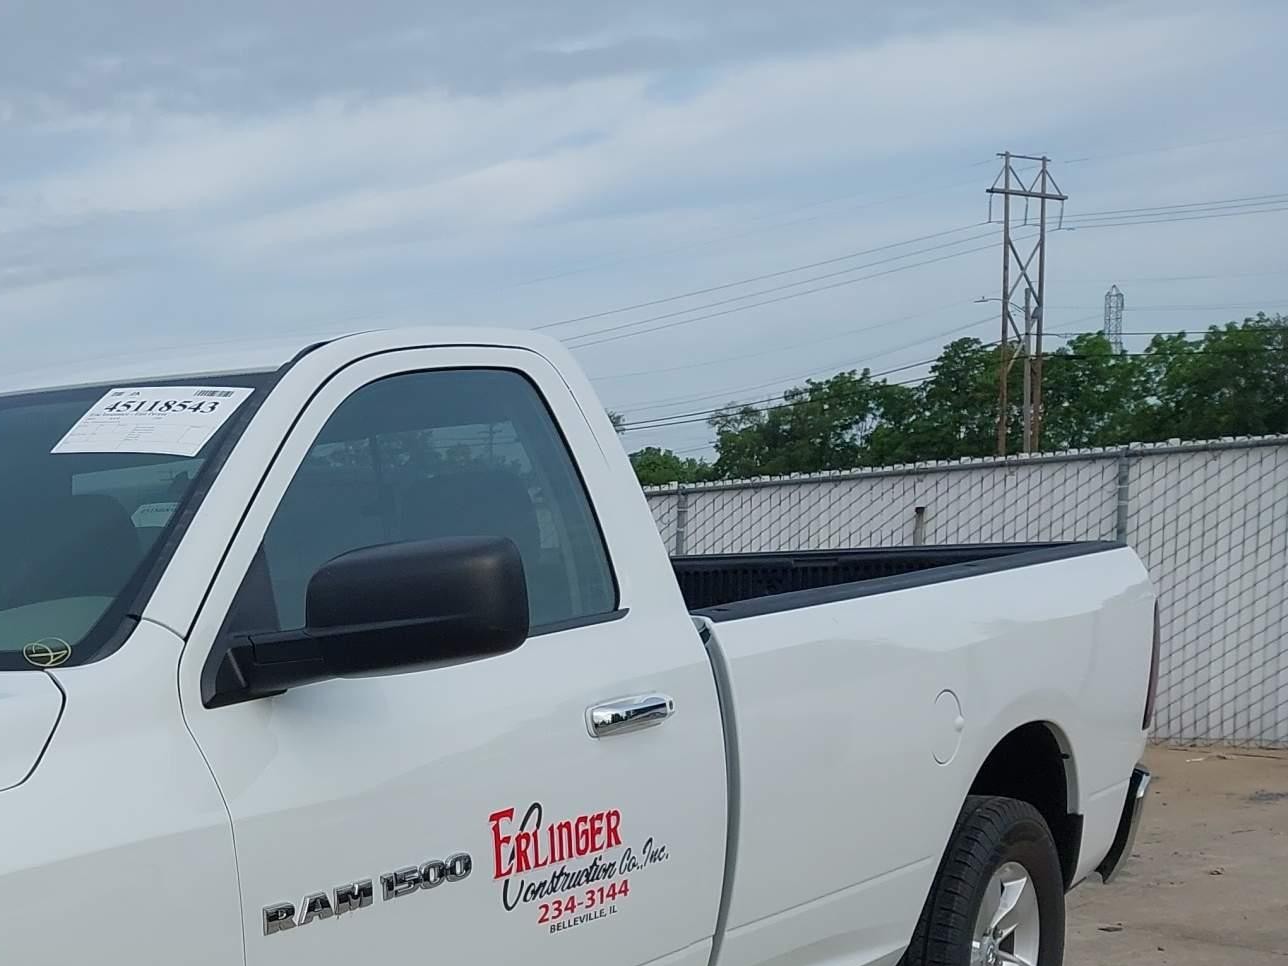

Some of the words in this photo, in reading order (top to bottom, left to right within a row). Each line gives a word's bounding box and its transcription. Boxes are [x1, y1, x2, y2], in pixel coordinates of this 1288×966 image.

[104, 400, 219, 414] 45118543
[263, 879, 374, 936] RAM
[380, 852, 472, 901] 1500
[537, 879, 630, 924] 234-3144
[549, 909, 607, 934] BELLEVILLE,
[609, 905, 618, 915] IL
